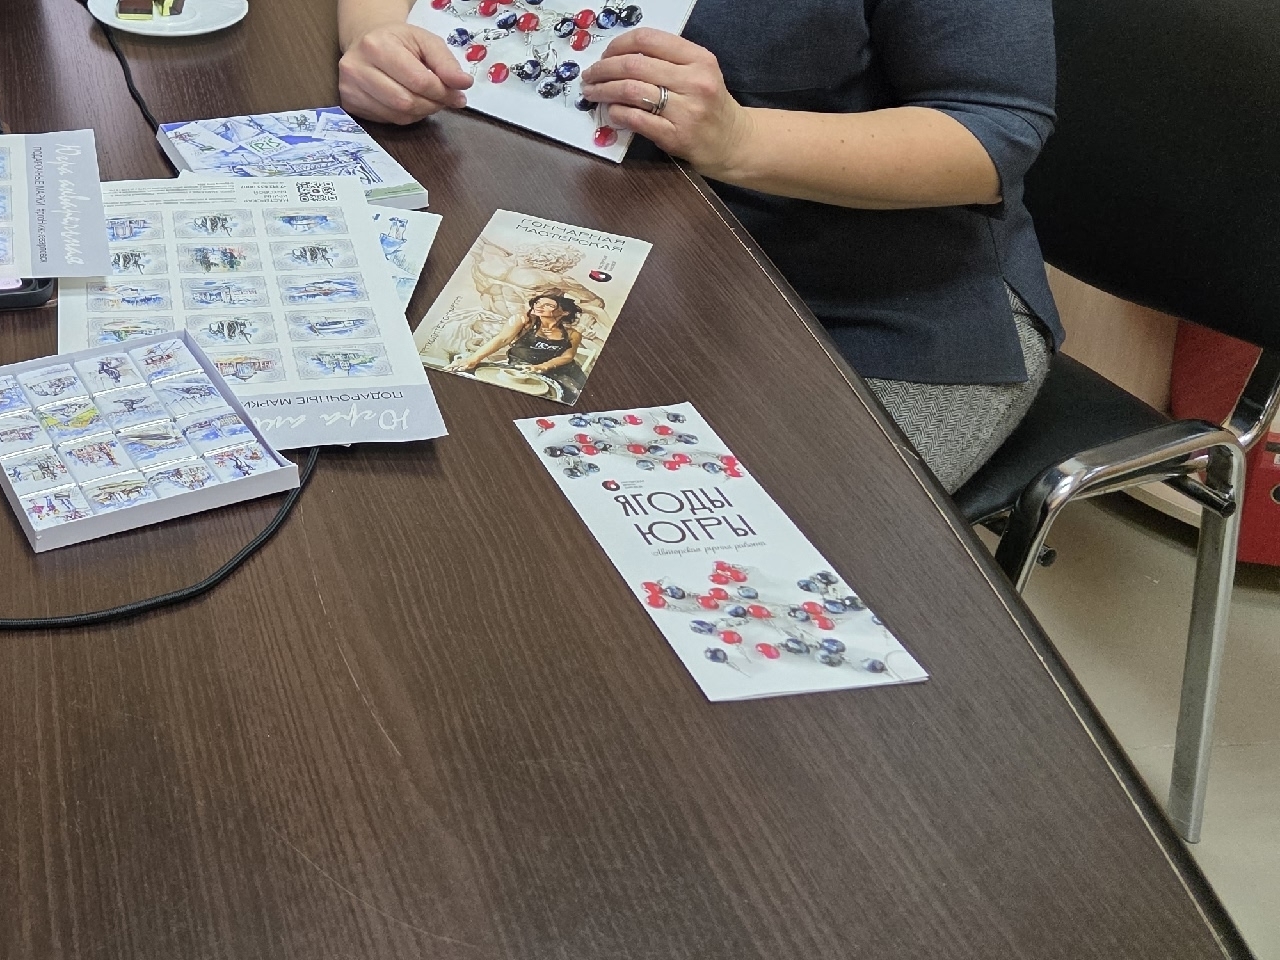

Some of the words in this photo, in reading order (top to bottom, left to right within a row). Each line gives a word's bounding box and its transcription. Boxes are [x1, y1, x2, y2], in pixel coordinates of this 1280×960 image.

[32, 146, 45, 185] ПОДАРОЧНЫЕ
[516, 224, 623, 253] МАСТЕРСКАЯ
[521, 218, 626, 246] ГОНЧАРНАЯ
[296, 390, 404, 405] ПОДАРОЧНЫЕ
[319, 402, 410, 431] Югра
[613, 486, 734, 517] ЯГОДЫ
[634, 514, 758, 545] ЮГРЫ
[652, 547, 702, 557] Авторская
[734, 541, 767, 553] работа
